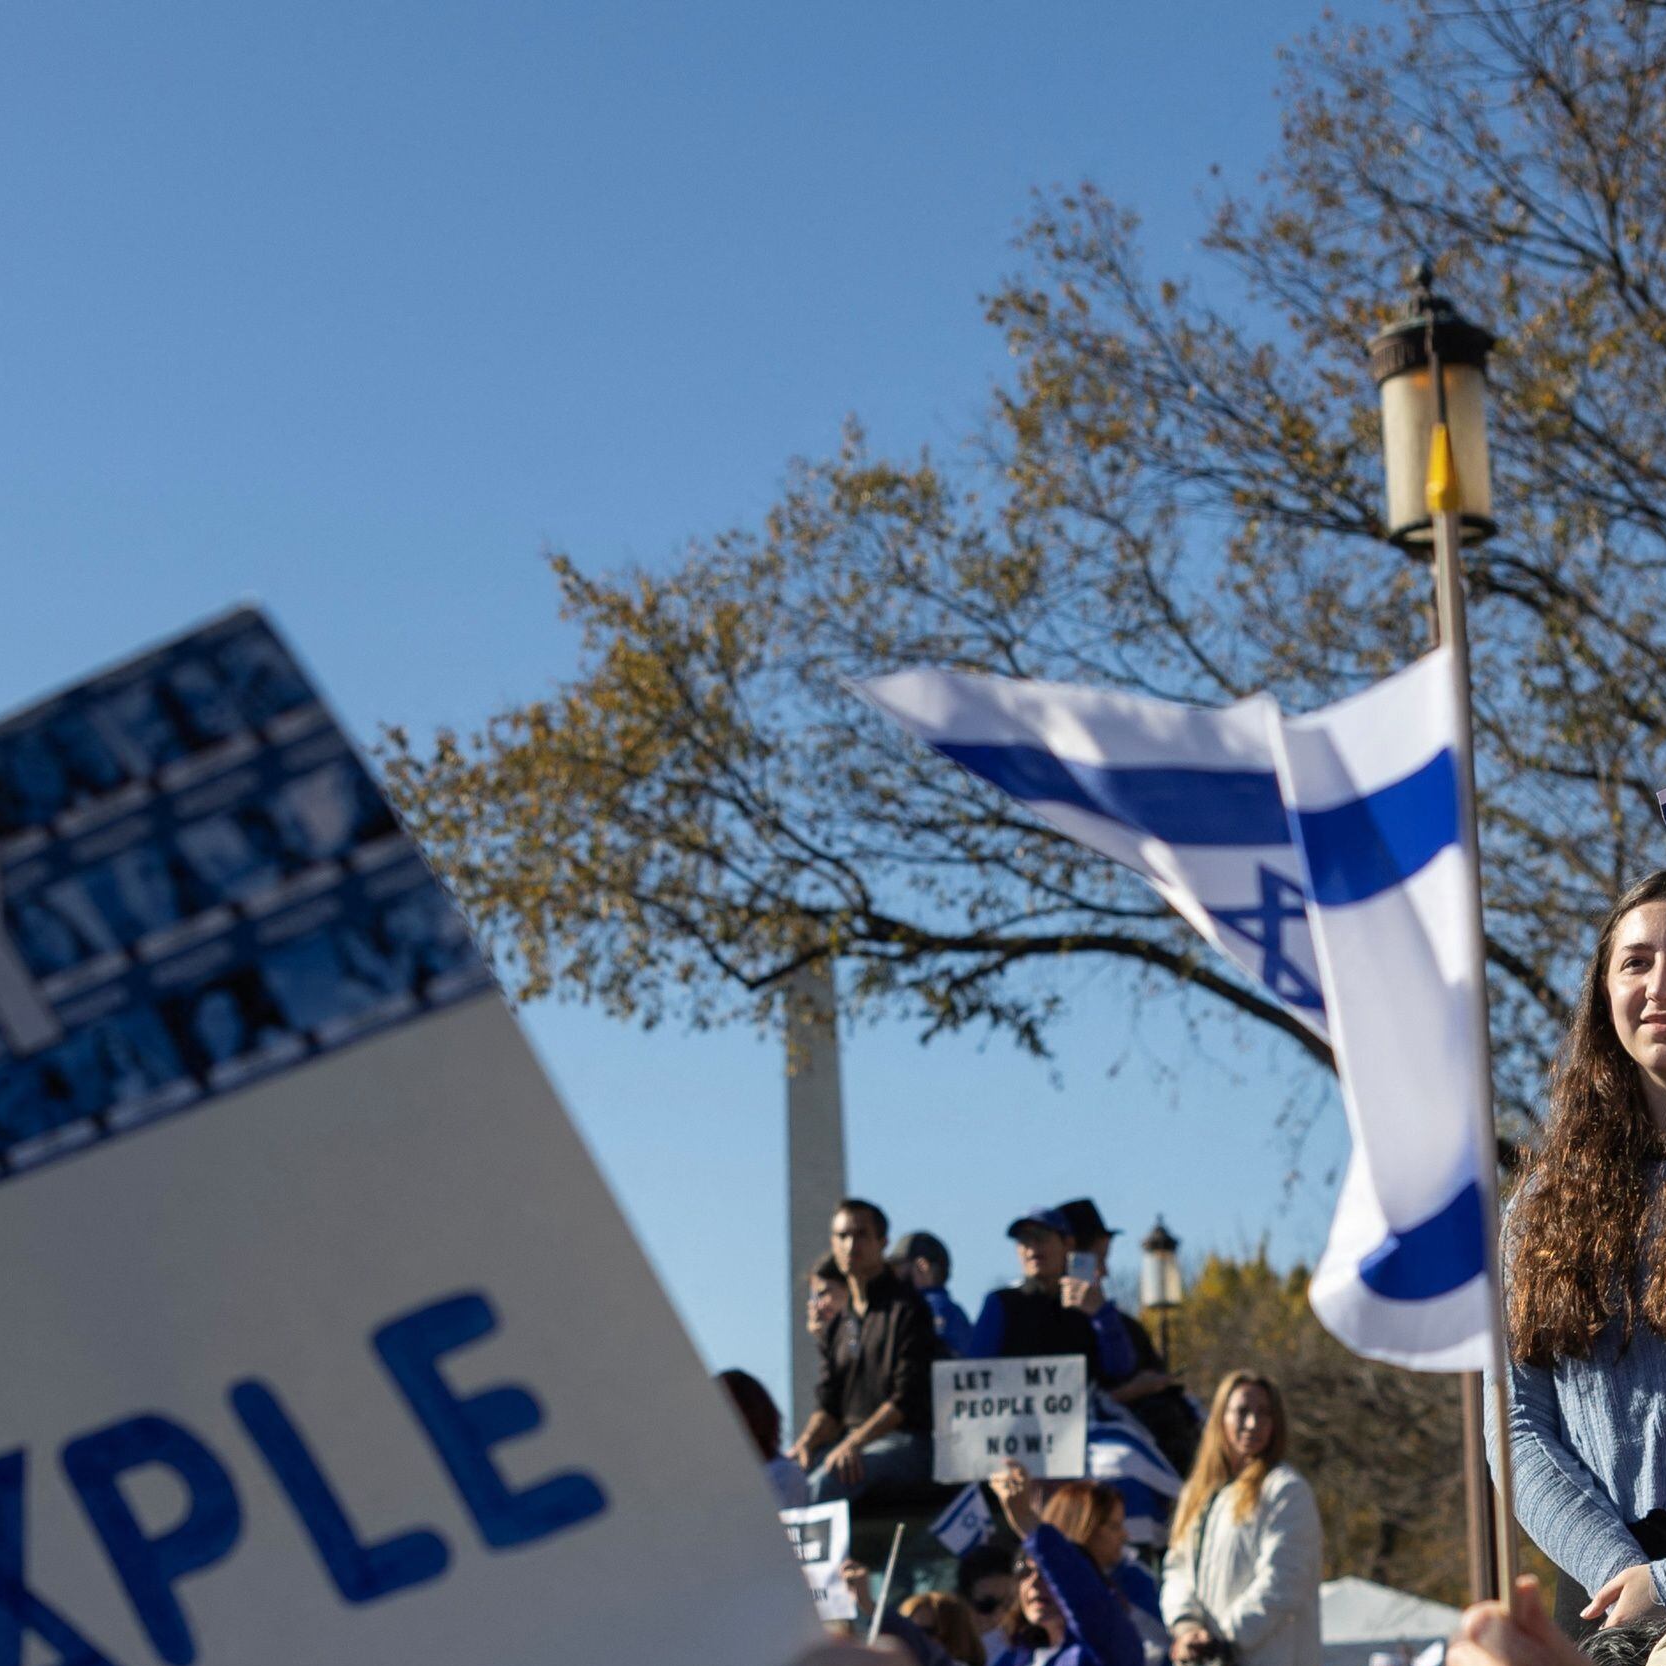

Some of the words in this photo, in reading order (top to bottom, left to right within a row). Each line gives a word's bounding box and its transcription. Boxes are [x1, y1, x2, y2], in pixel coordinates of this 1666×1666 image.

[953, 1369, 993, 1391] LET
[1024, 1365, 1057, 1386] MY
[954, 1396, 1035, 1419] PEOPLE
[1044, 1394, 1072, 1414] GO
[986, 1433, 1053, 1455] NOW!
